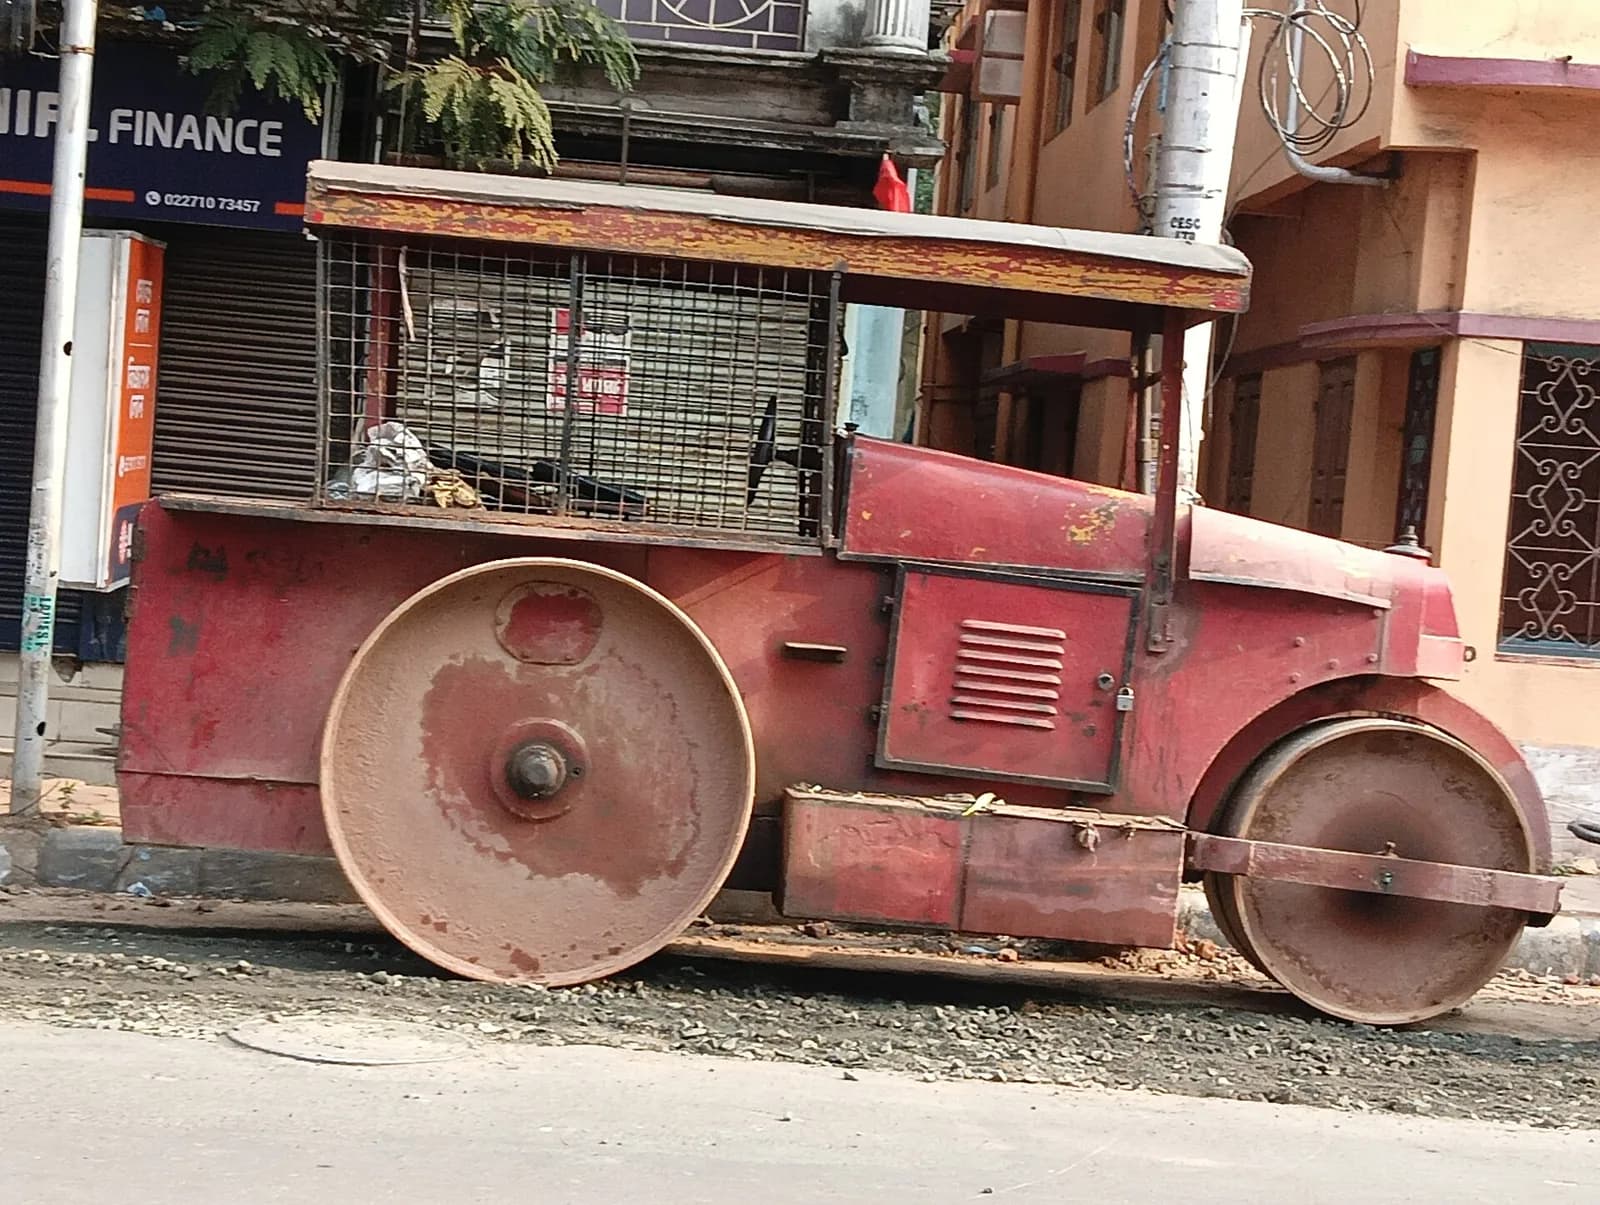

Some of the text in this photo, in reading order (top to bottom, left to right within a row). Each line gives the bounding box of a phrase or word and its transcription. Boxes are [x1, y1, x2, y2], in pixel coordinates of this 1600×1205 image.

[109, 108, 283, 157] FINANCE
[164, 193, 261, 213] 022710 73457
[1170, 216, 1201, 229] CESC
